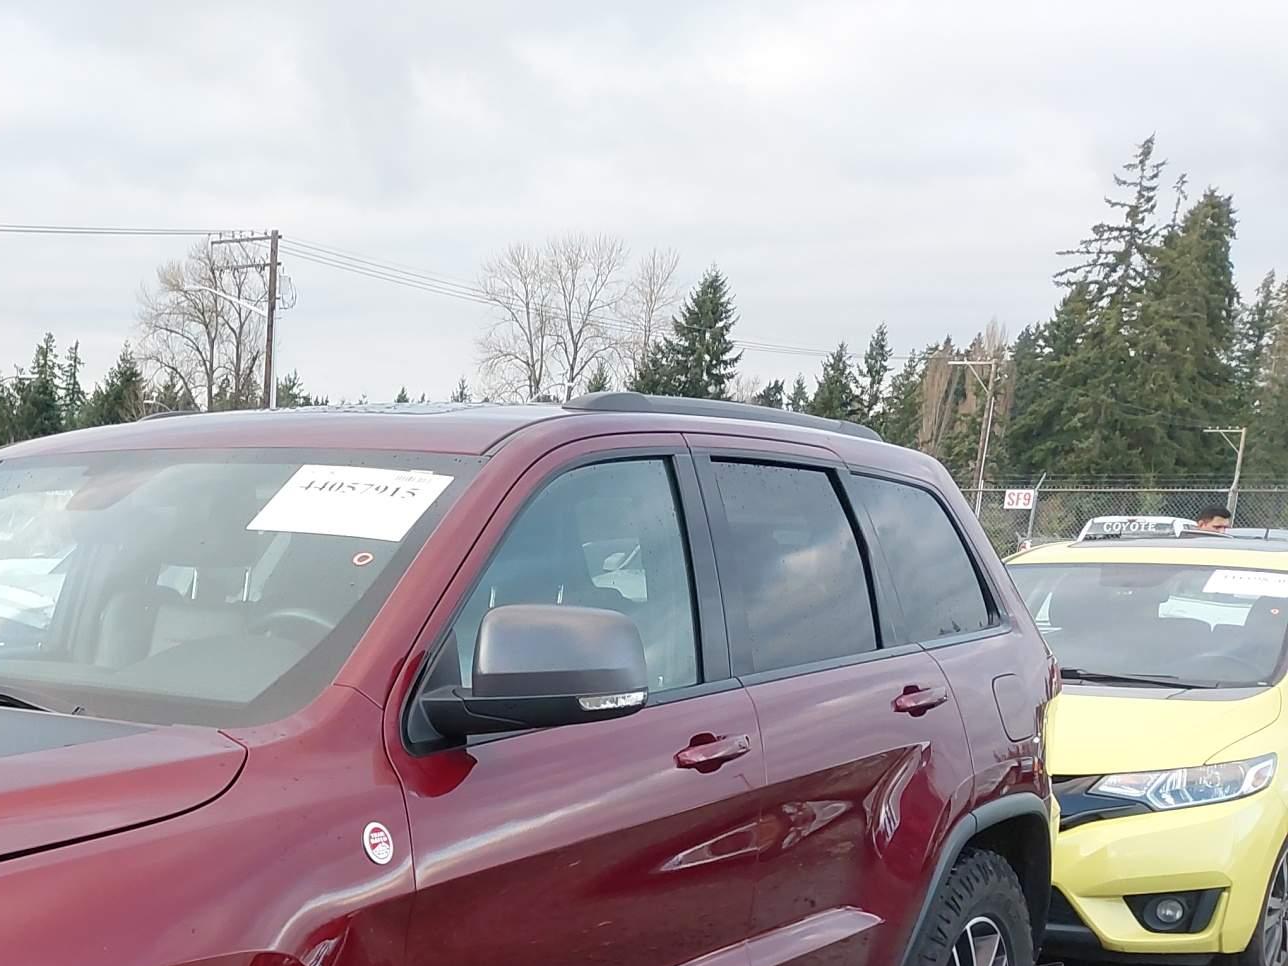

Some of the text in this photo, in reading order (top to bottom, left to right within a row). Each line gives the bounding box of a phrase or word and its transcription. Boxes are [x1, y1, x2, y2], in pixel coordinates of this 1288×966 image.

[299, 480, 421, 499] 44057915
[1006, 491, 1032, 507] SF9
[1103, 521, 1157, 533] COYOTE
